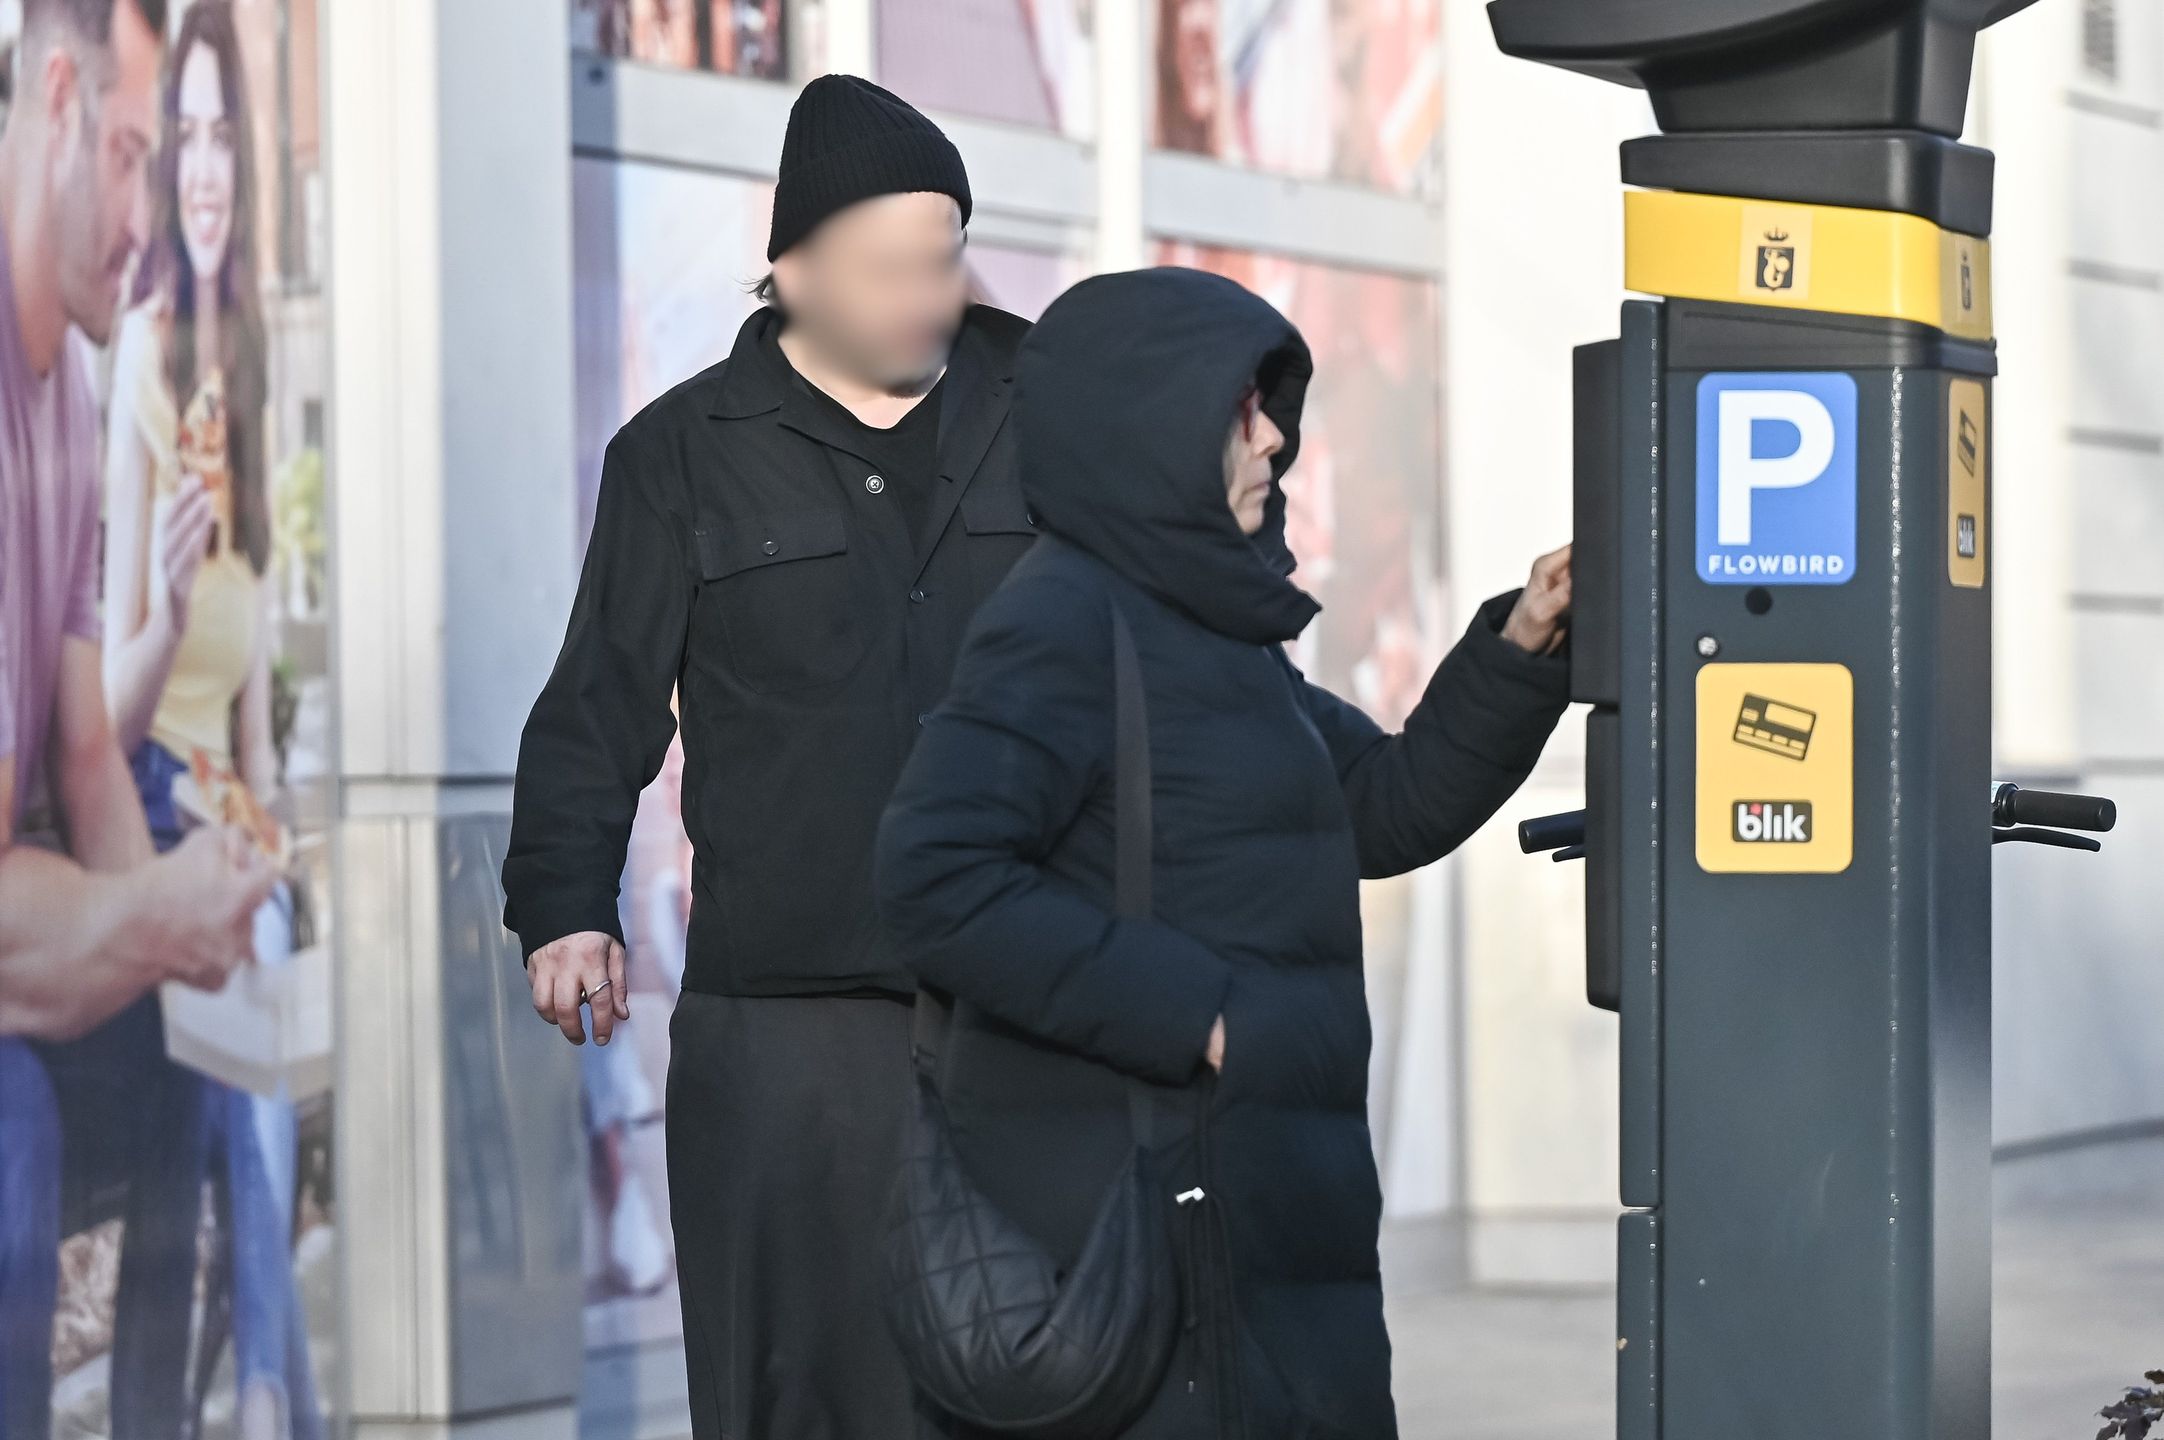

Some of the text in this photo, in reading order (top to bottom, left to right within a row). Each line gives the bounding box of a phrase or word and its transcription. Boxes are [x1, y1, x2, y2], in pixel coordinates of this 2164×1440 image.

[1718, 389, 1835, 545] P
[1708, 555, 1844, 575] FLOWBIRD
[1738, 803, 1807, 841] blik
